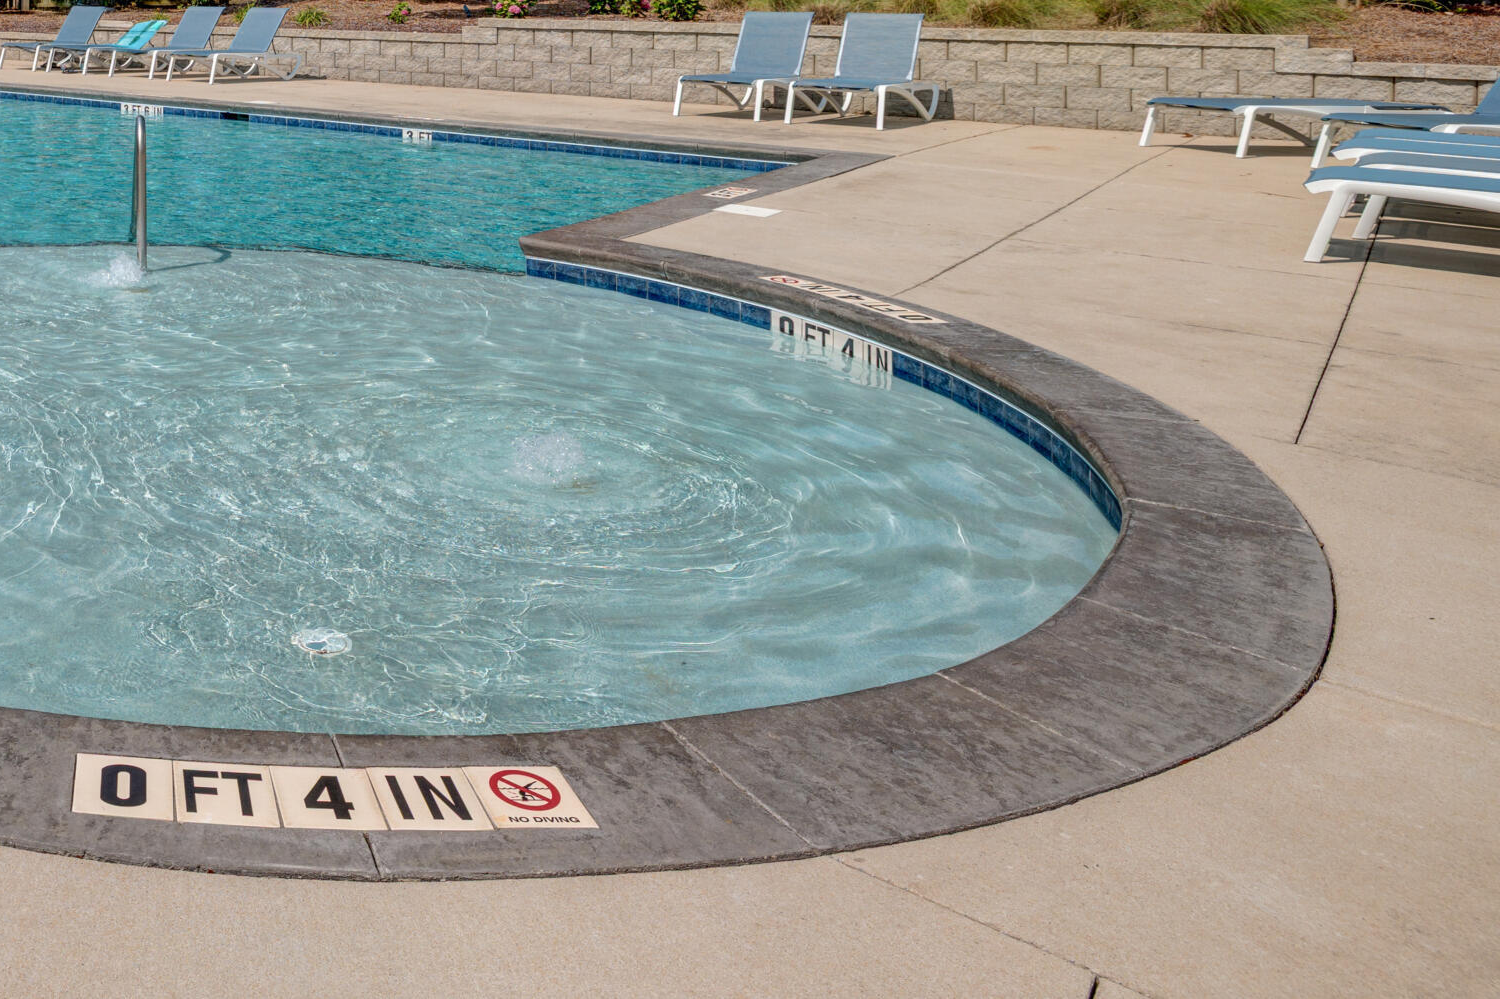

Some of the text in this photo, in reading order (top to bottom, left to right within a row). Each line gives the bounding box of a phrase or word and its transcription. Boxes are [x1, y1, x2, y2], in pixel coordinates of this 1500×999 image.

[805, 322, 831, 348] FT
[867, 344, 889, 372] IN
[182, 769, 263, 817] FT
[303, 775, 355, 820] 4
[385, 775, 473, 821] IN
[532, 816, 581, 824] DIVING
